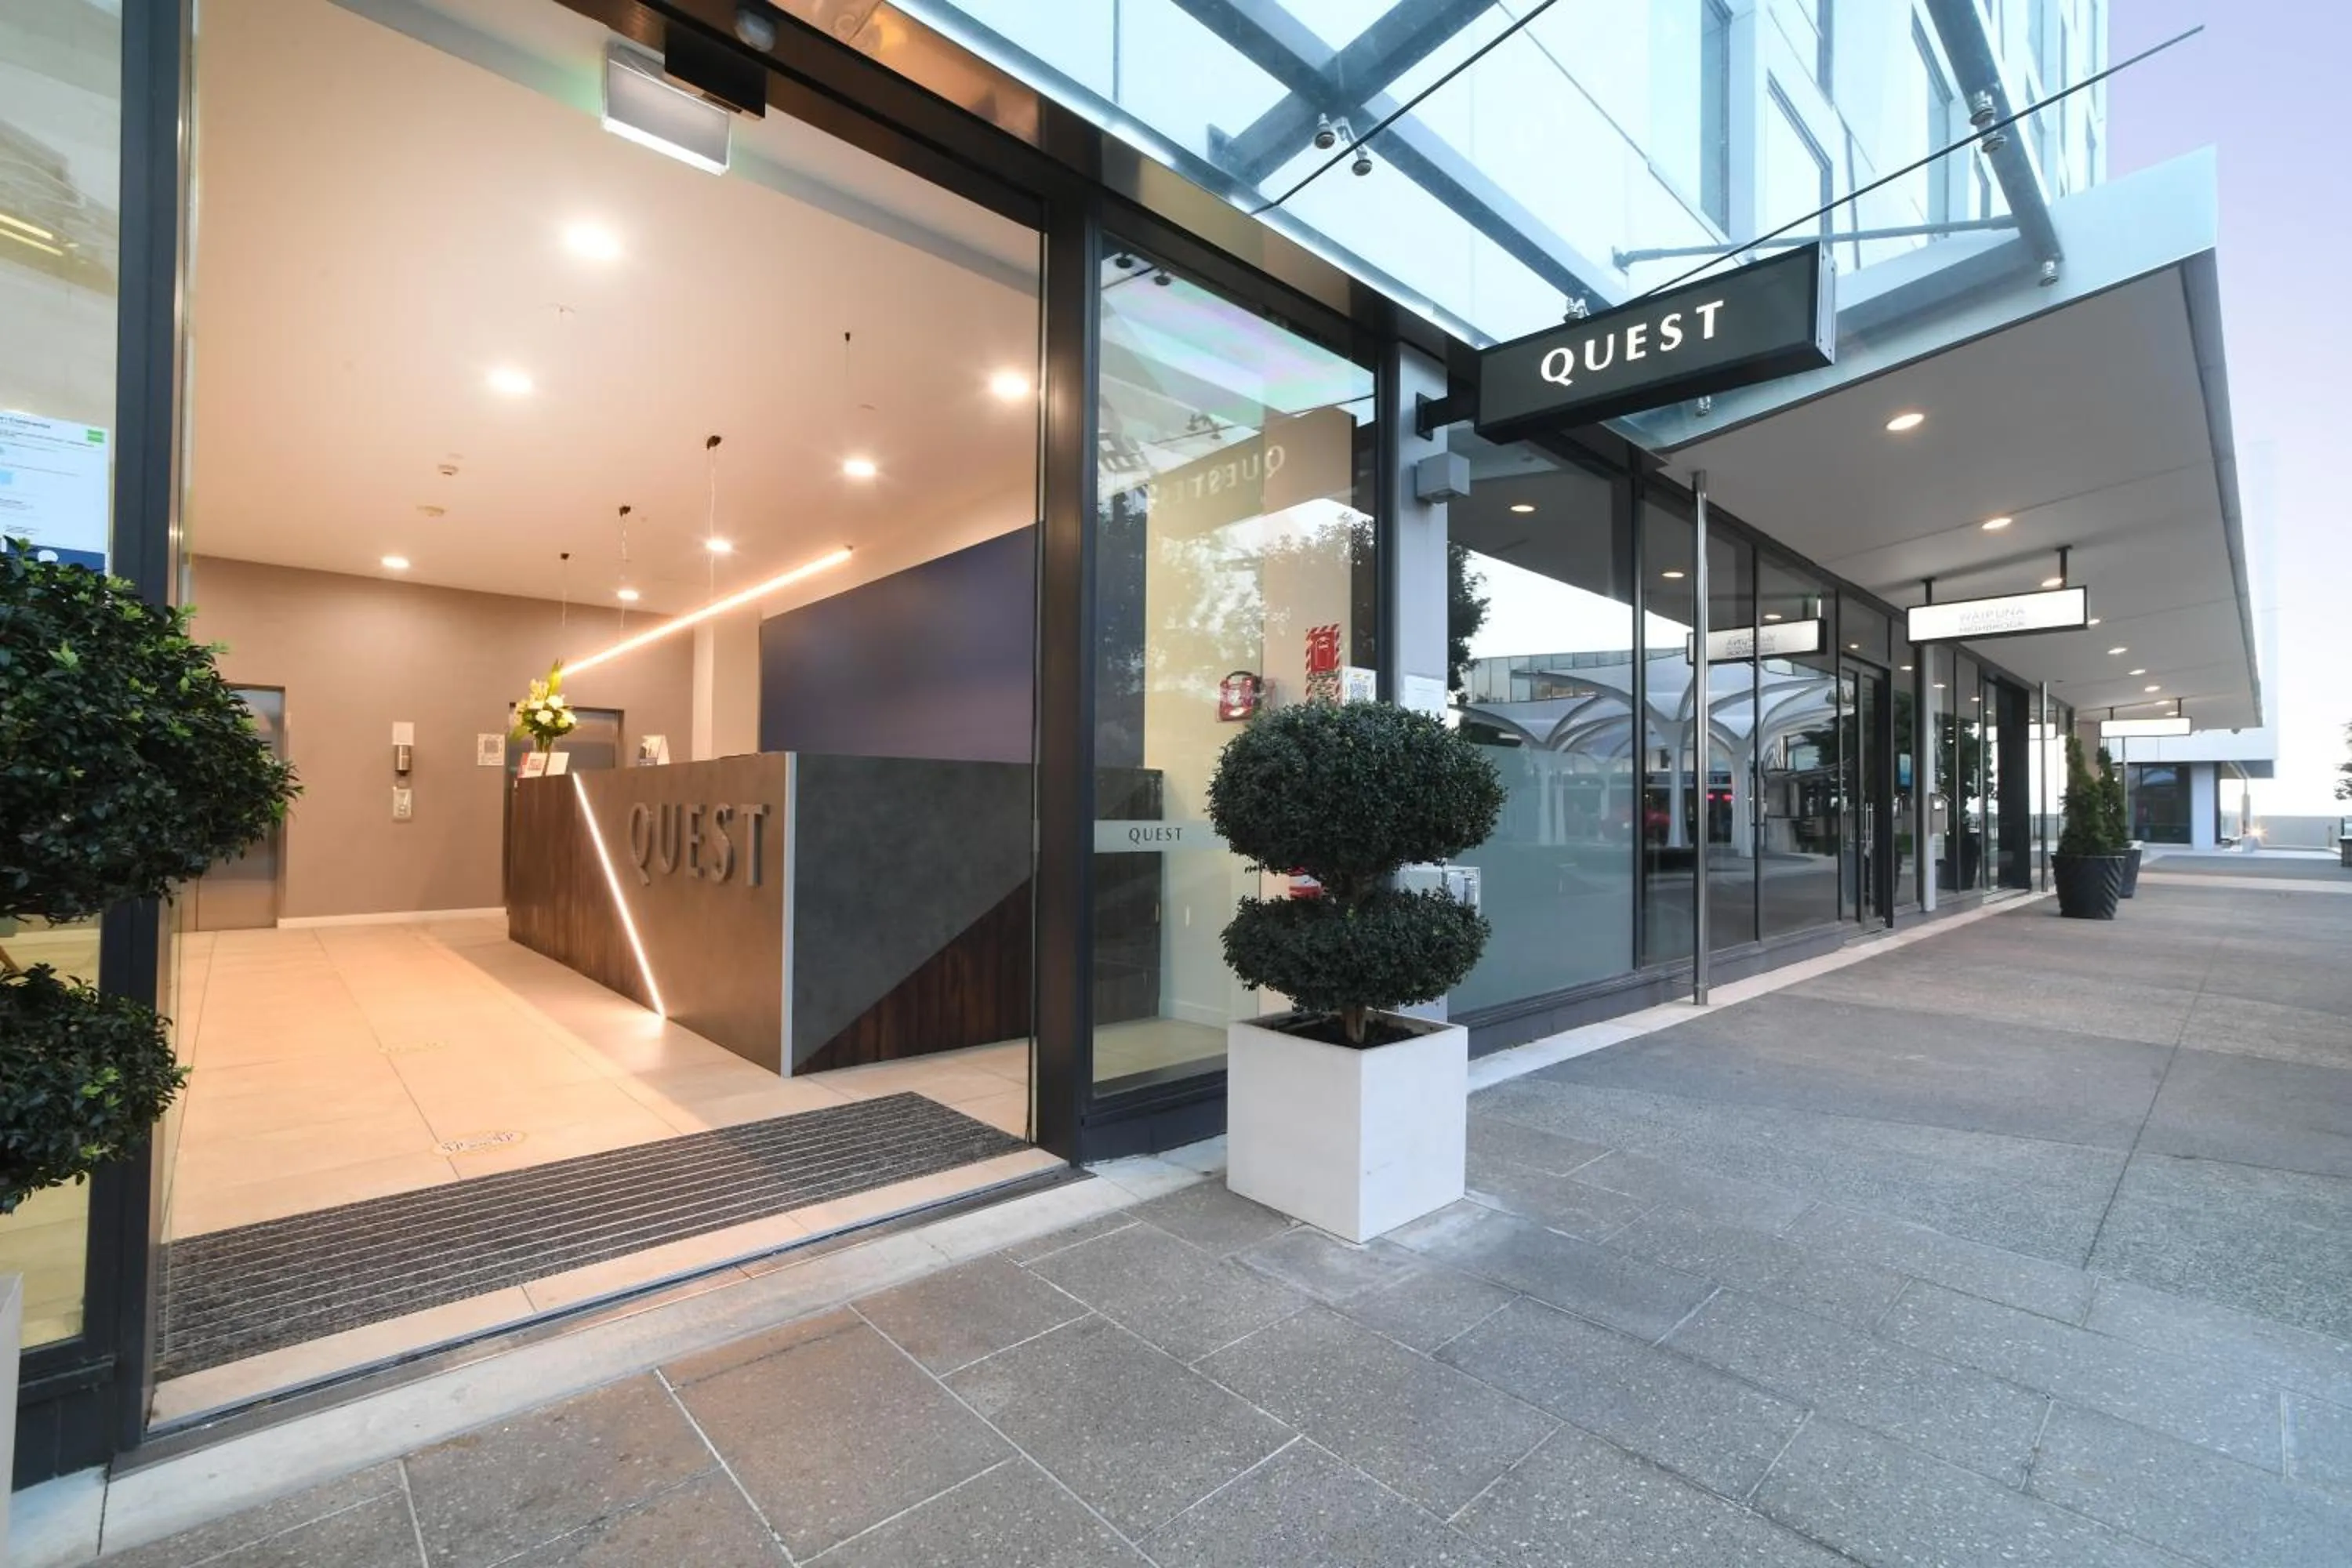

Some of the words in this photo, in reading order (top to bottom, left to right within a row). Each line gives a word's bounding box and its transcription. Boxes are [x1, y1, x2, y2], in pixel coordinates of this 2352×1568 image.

[1541, 299, 1723, 386] QUEST
[628, 802, 770, 887] QUEST
[1129, 827, 1181, 844] QUEST
